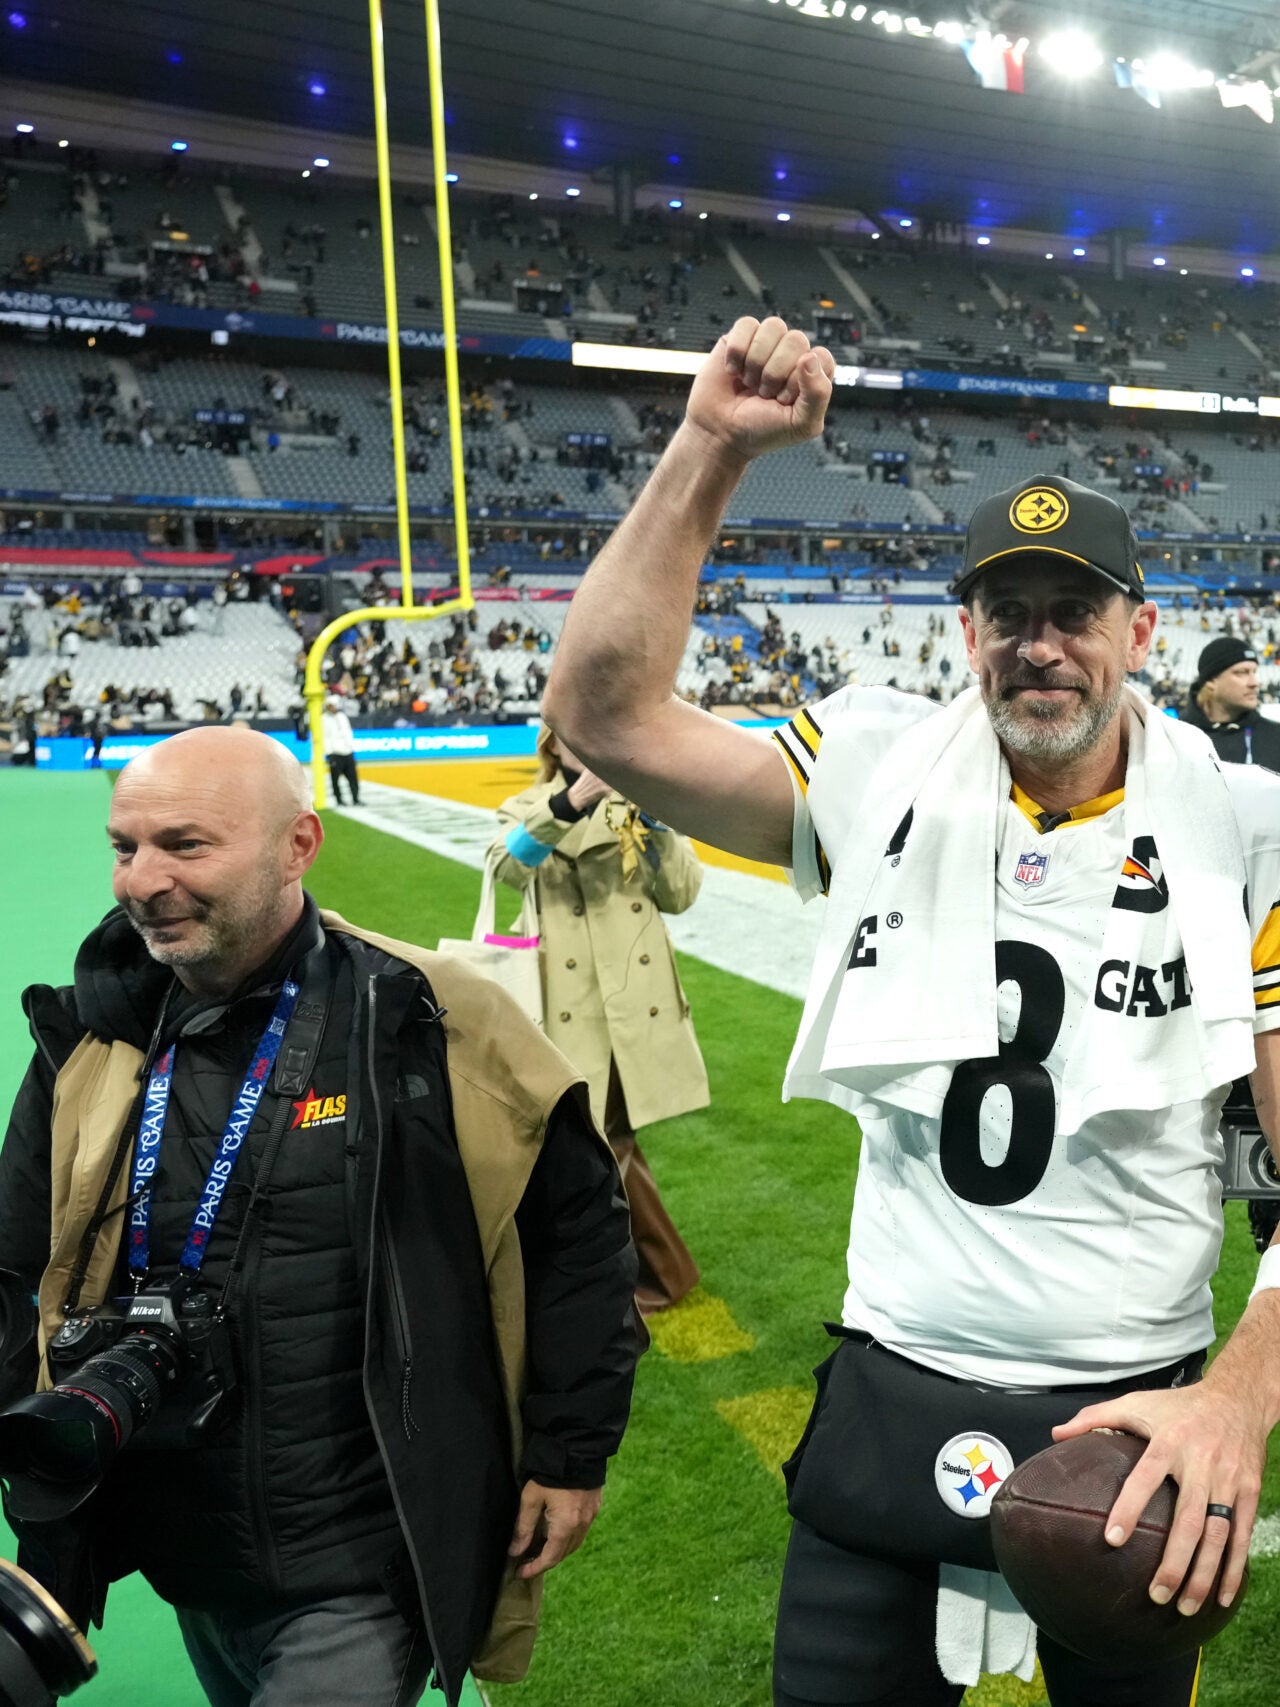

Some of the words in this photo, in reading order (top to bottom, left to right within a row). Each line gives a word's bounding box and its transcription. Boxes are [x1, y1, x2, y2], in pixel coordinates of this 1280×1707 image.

[1017, 864, 1041, 882] NFL
[939, 939, 1066, 1207] 8
[141, 1077, 169, 1153] GAME
[195, 1159, 232, 1229] PARIS
[222, 1081, 263, 1155] GAME
[130, 1306, 161, 1316] Nikon
[942, 1461, 971, 1477] Steelers
